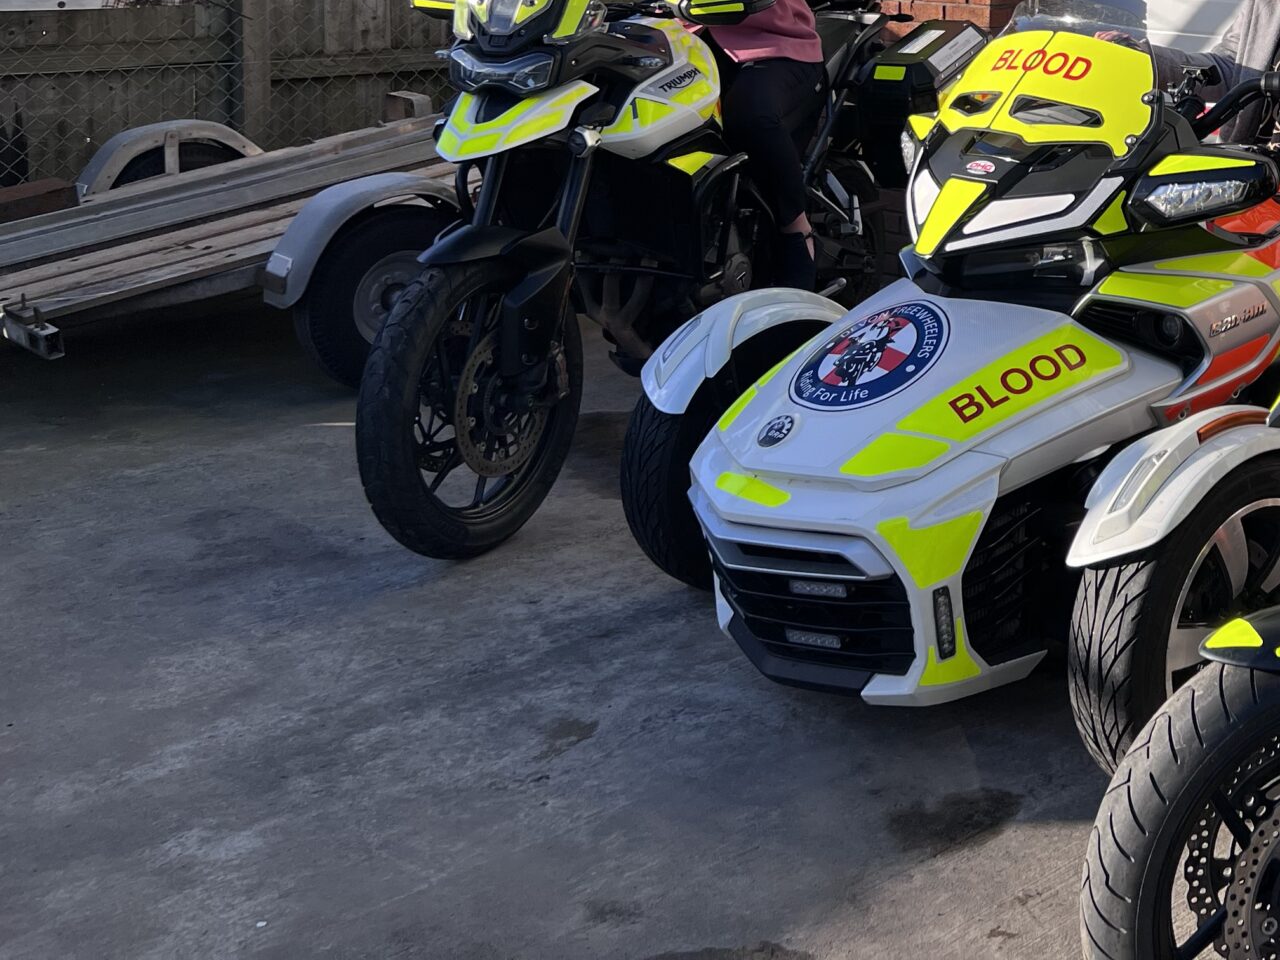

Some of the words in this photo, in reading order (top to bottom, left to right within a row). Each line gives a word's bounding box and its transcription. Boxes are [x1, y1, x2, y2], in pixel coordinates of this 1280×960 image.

[991, 48, 1093, 81] BLOOD
[658, 67, 702, 92] TRIUMPH
[813, 387, 838, 401] For
[840, 388, 869, 402] Life
[948, 343, 1087, 424] BLOOD
